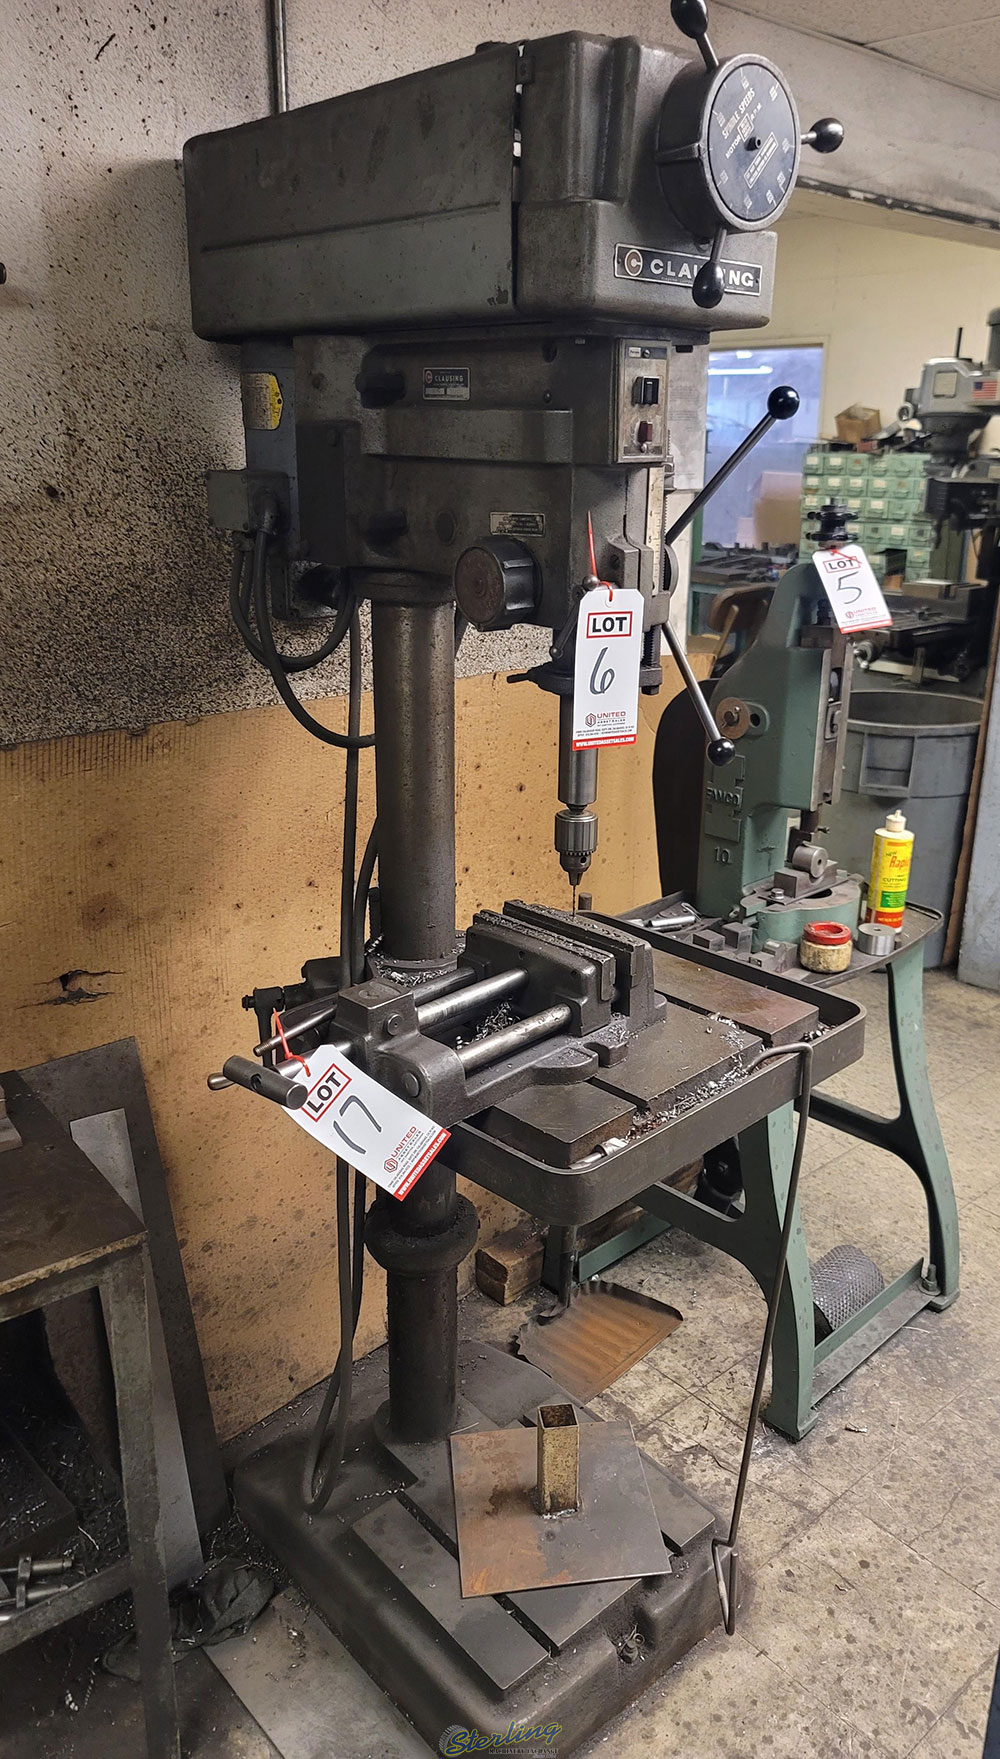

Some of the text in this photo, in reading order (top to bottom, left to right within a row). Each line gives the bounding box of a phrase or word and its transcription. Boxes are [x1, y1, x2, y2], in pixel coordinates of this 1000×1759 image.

[725, 134, 742, 159] MOTOR
[650, 258, 754, 287] CLANG
[434, 374, 464, 382] CLAUSING
[828, 559, 854, 570] LOT
[837, 571, 862, 604] 5
[592, 616, 627, 633] LOT
[589, 646, 615, 695] 6
[597, 711, 626, 719] UNITED
[714, 846, 730, 863] 10
[306, 1071, 341, 1113] LOT
[333, 1095, 382, 1155] 17
[391, 1126, 417, 1158] UNITED
